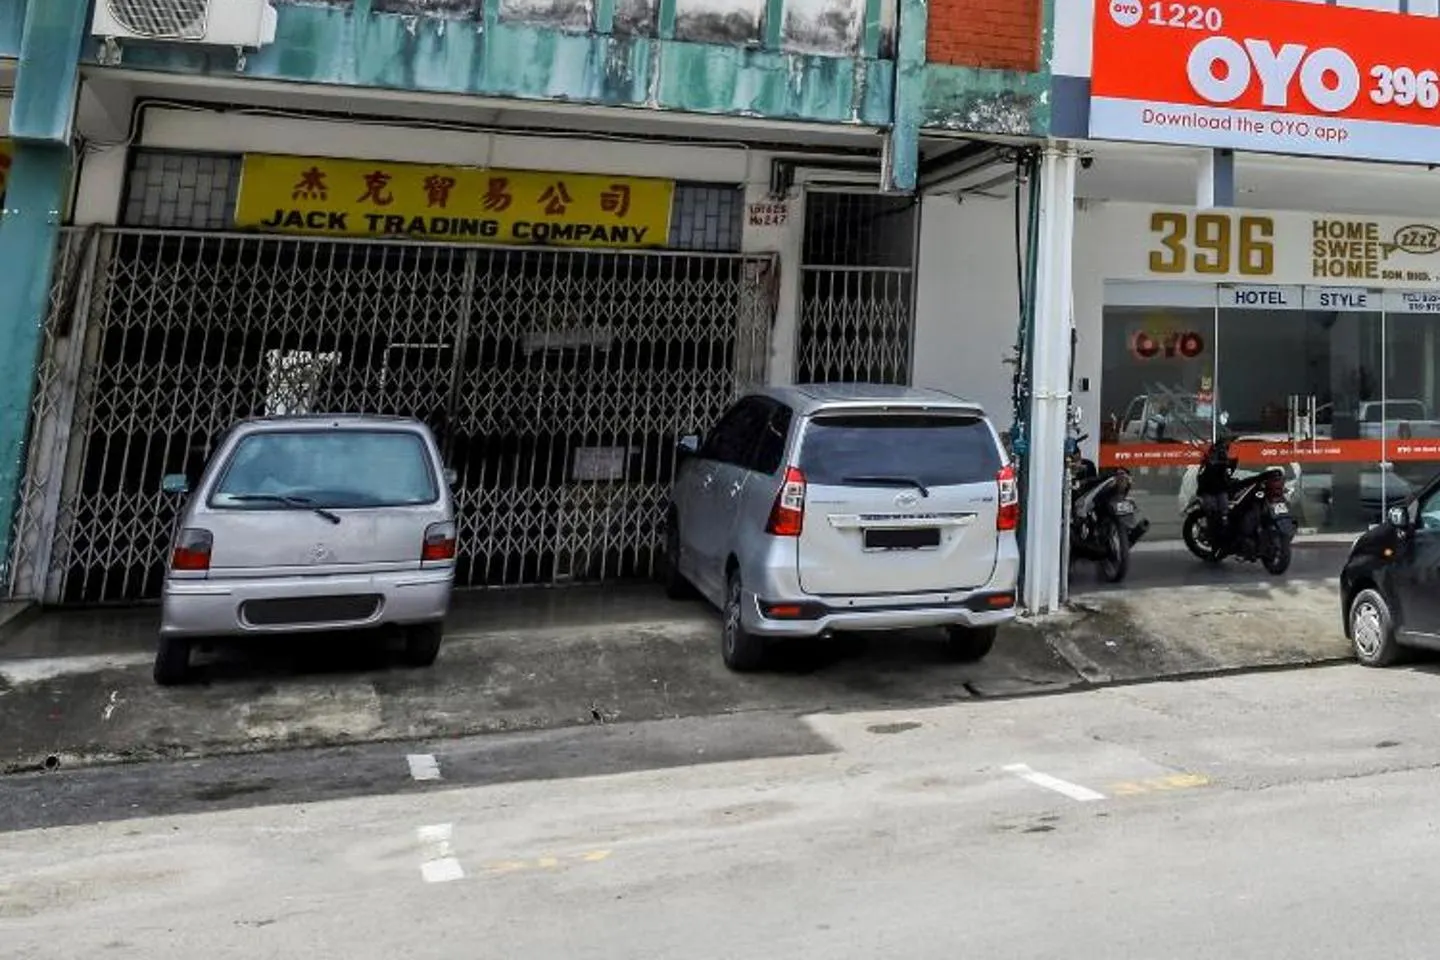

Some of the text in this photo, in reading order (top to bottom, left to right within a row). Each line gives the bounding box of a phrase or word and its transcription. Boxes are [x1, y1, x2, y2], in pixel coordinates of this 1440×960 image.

[1113, 1, 1223, 31] OYO 1220
[1186, 36, 1360, 113] OYO
[1369, 64, 1440, 110] 396
[1142, 108, 1349, 142] Download the OYO app
[292, 166, 631, 218] 杰克貿易公司
[261, 209, 648, 243] JACK TRADING COMPANY
[1312, 220, 1379, 241] HOME
[1149, 212, 1274, 275] 396
[1312, 239, 1395, 261] SWEET
[1312, 259, 1379, 279] HOME
[1235, 291, 1287, 306] HOTEL
[1320, 293, 1367, 308] STYLE
[1132, 331, 1203, 358] OYO
